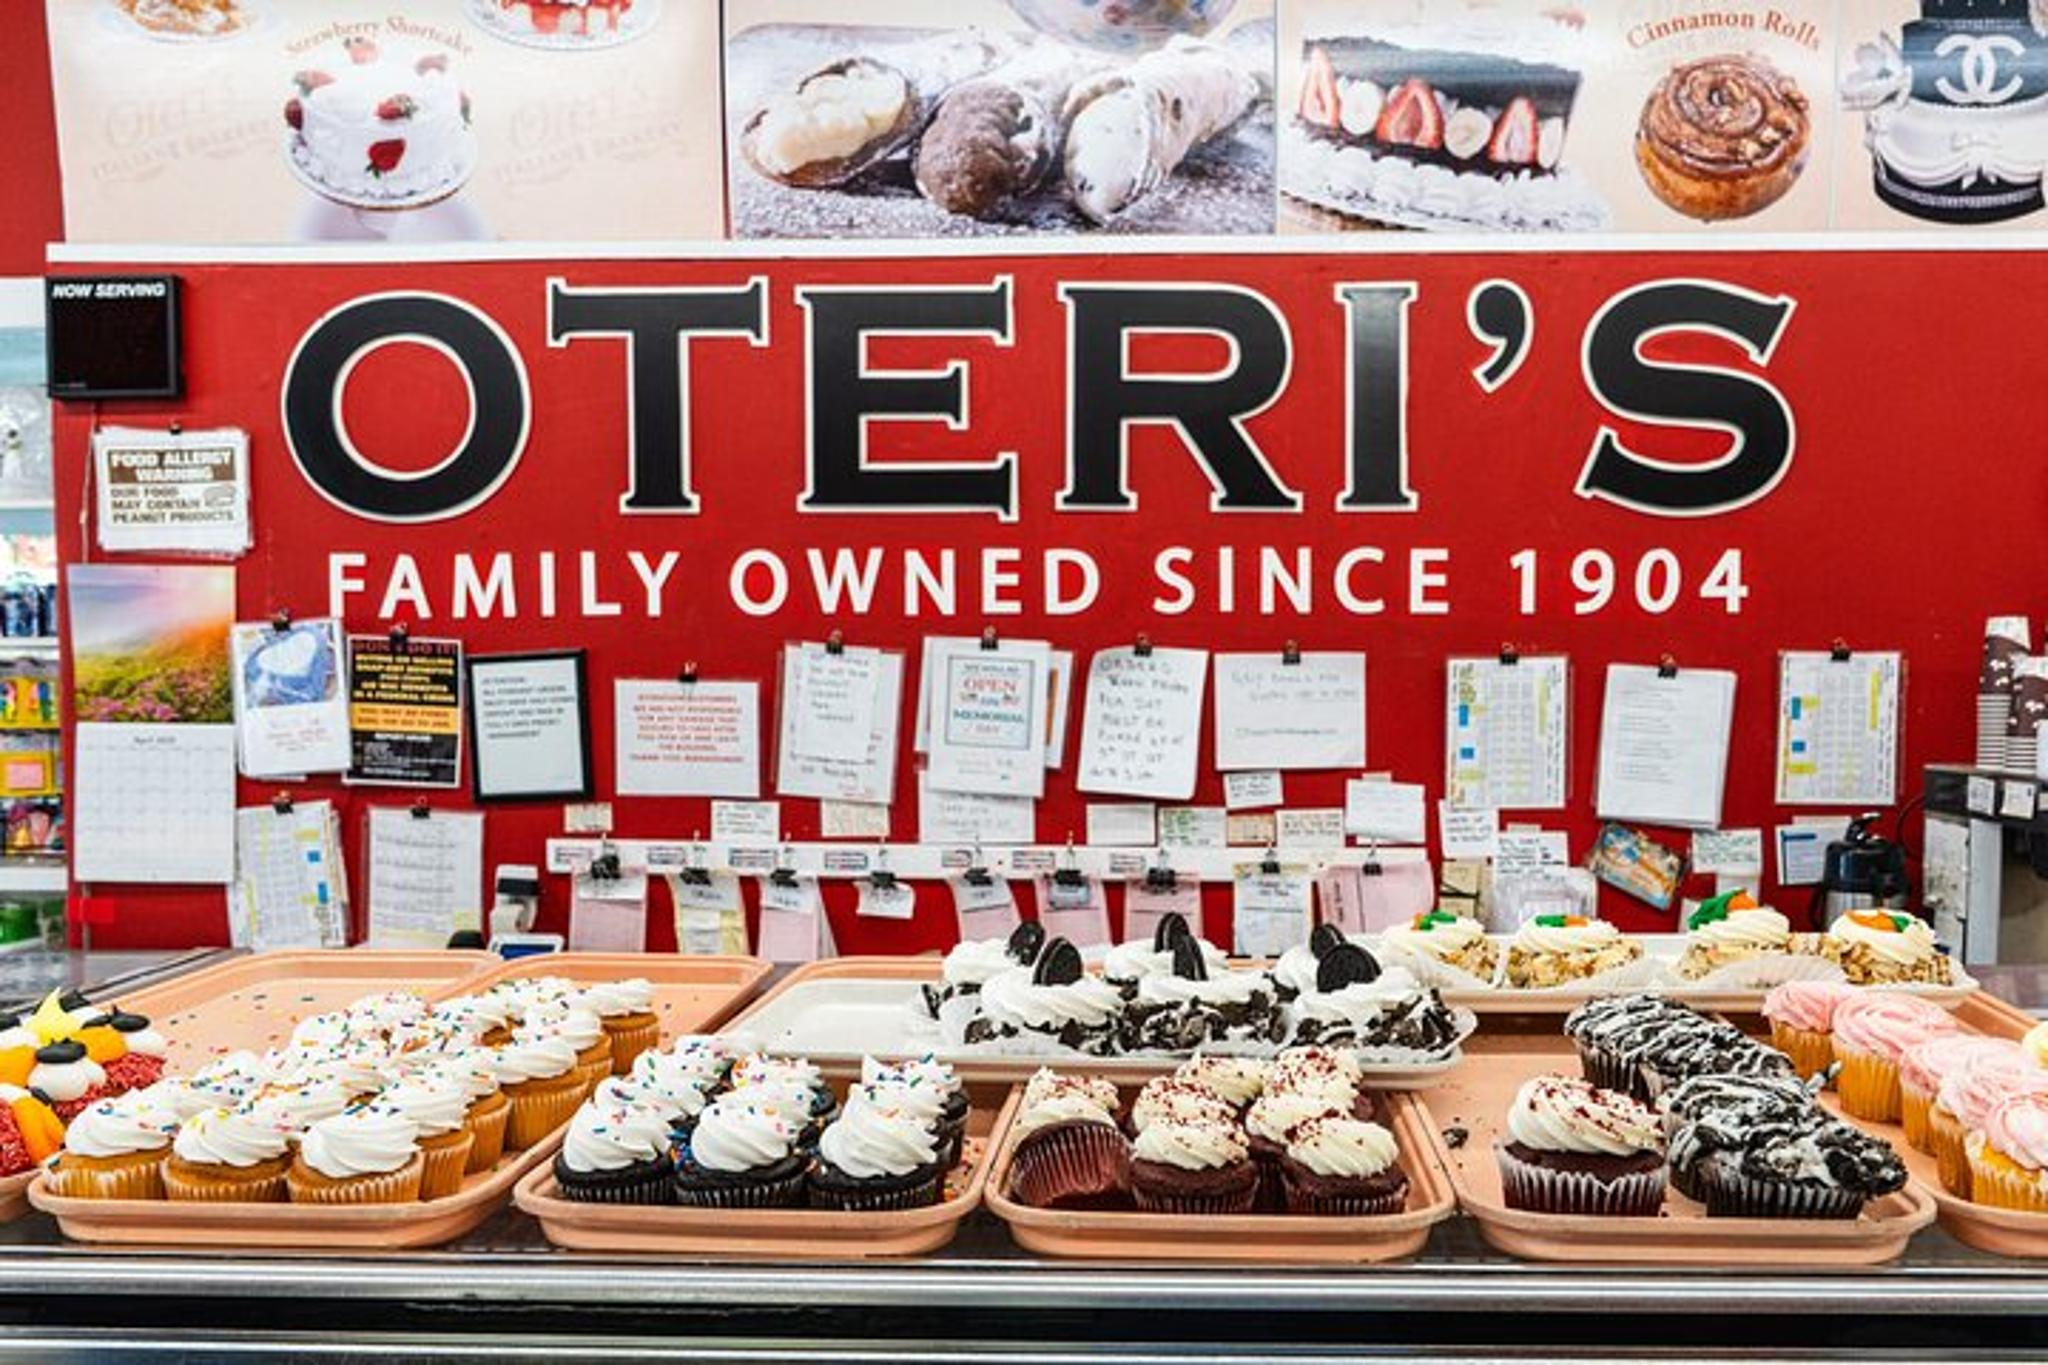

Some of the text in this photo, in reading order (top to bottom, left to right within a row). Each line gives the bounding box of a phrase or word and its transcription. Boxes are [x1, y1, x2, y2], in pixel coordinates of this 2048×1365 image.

[286, 14, 474, 57] Strawberry Shortcake
[1626, 9, 1820, 49] Cinnamon Rolls
[52, 281, 166, 298] NOW SERVING
[281, 275, 1797, 523] OTERI'S
[110, 450, 232, 467] FOOD ALLERGY
[135, 466, 214, 482] WARNING
[110, 487, 179, 498] OUR FOOD
[112, 498, 201, 509] MAY CONTAIN
[113, 510, 235, 523] PEANUT PRODUCTS
[327, 546, 1749, 620] FAMILY OWNED SINCE 1904
[1098, 658, 1173, 675] ORDERS
[963, 676, 1017, 693] OPEN
[952, 708, 1025, 723] MEMORIAL
